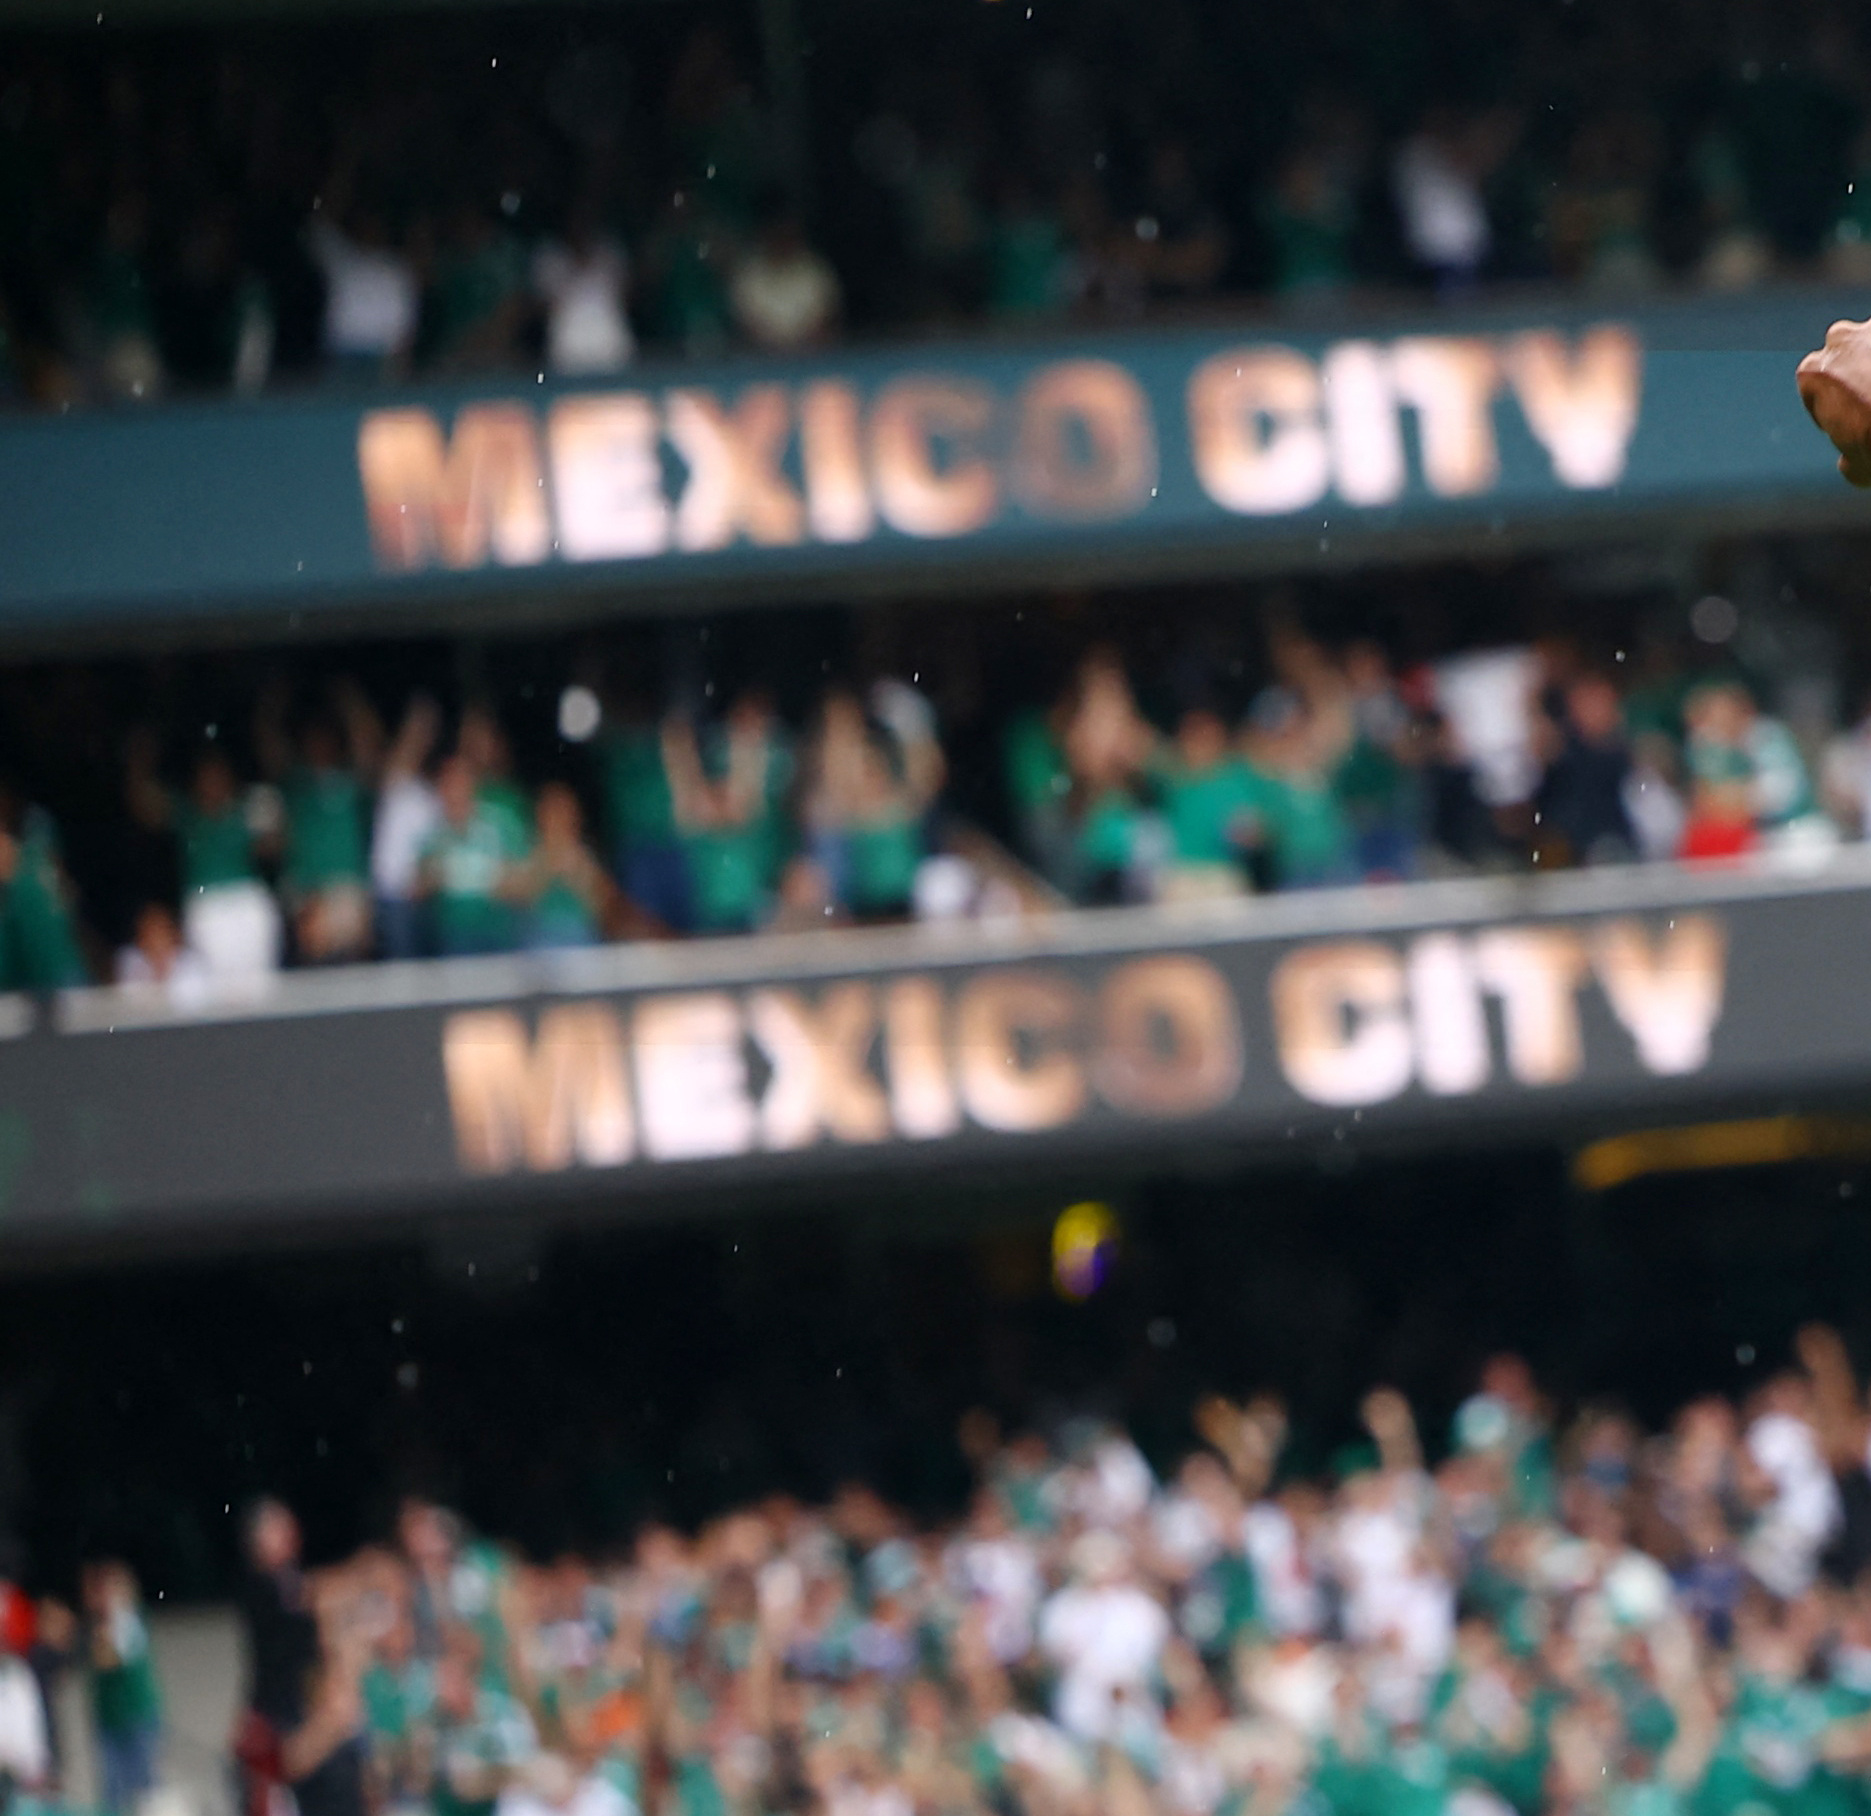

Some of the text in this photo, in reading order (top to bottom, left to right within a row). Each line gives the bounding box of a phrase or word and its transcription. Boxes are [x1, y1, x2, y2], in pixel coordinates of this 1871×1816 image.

[355, 325, 1644, 570] MEXICO CITY
[440, 912, 1730, 1176] MEXICO CITY
